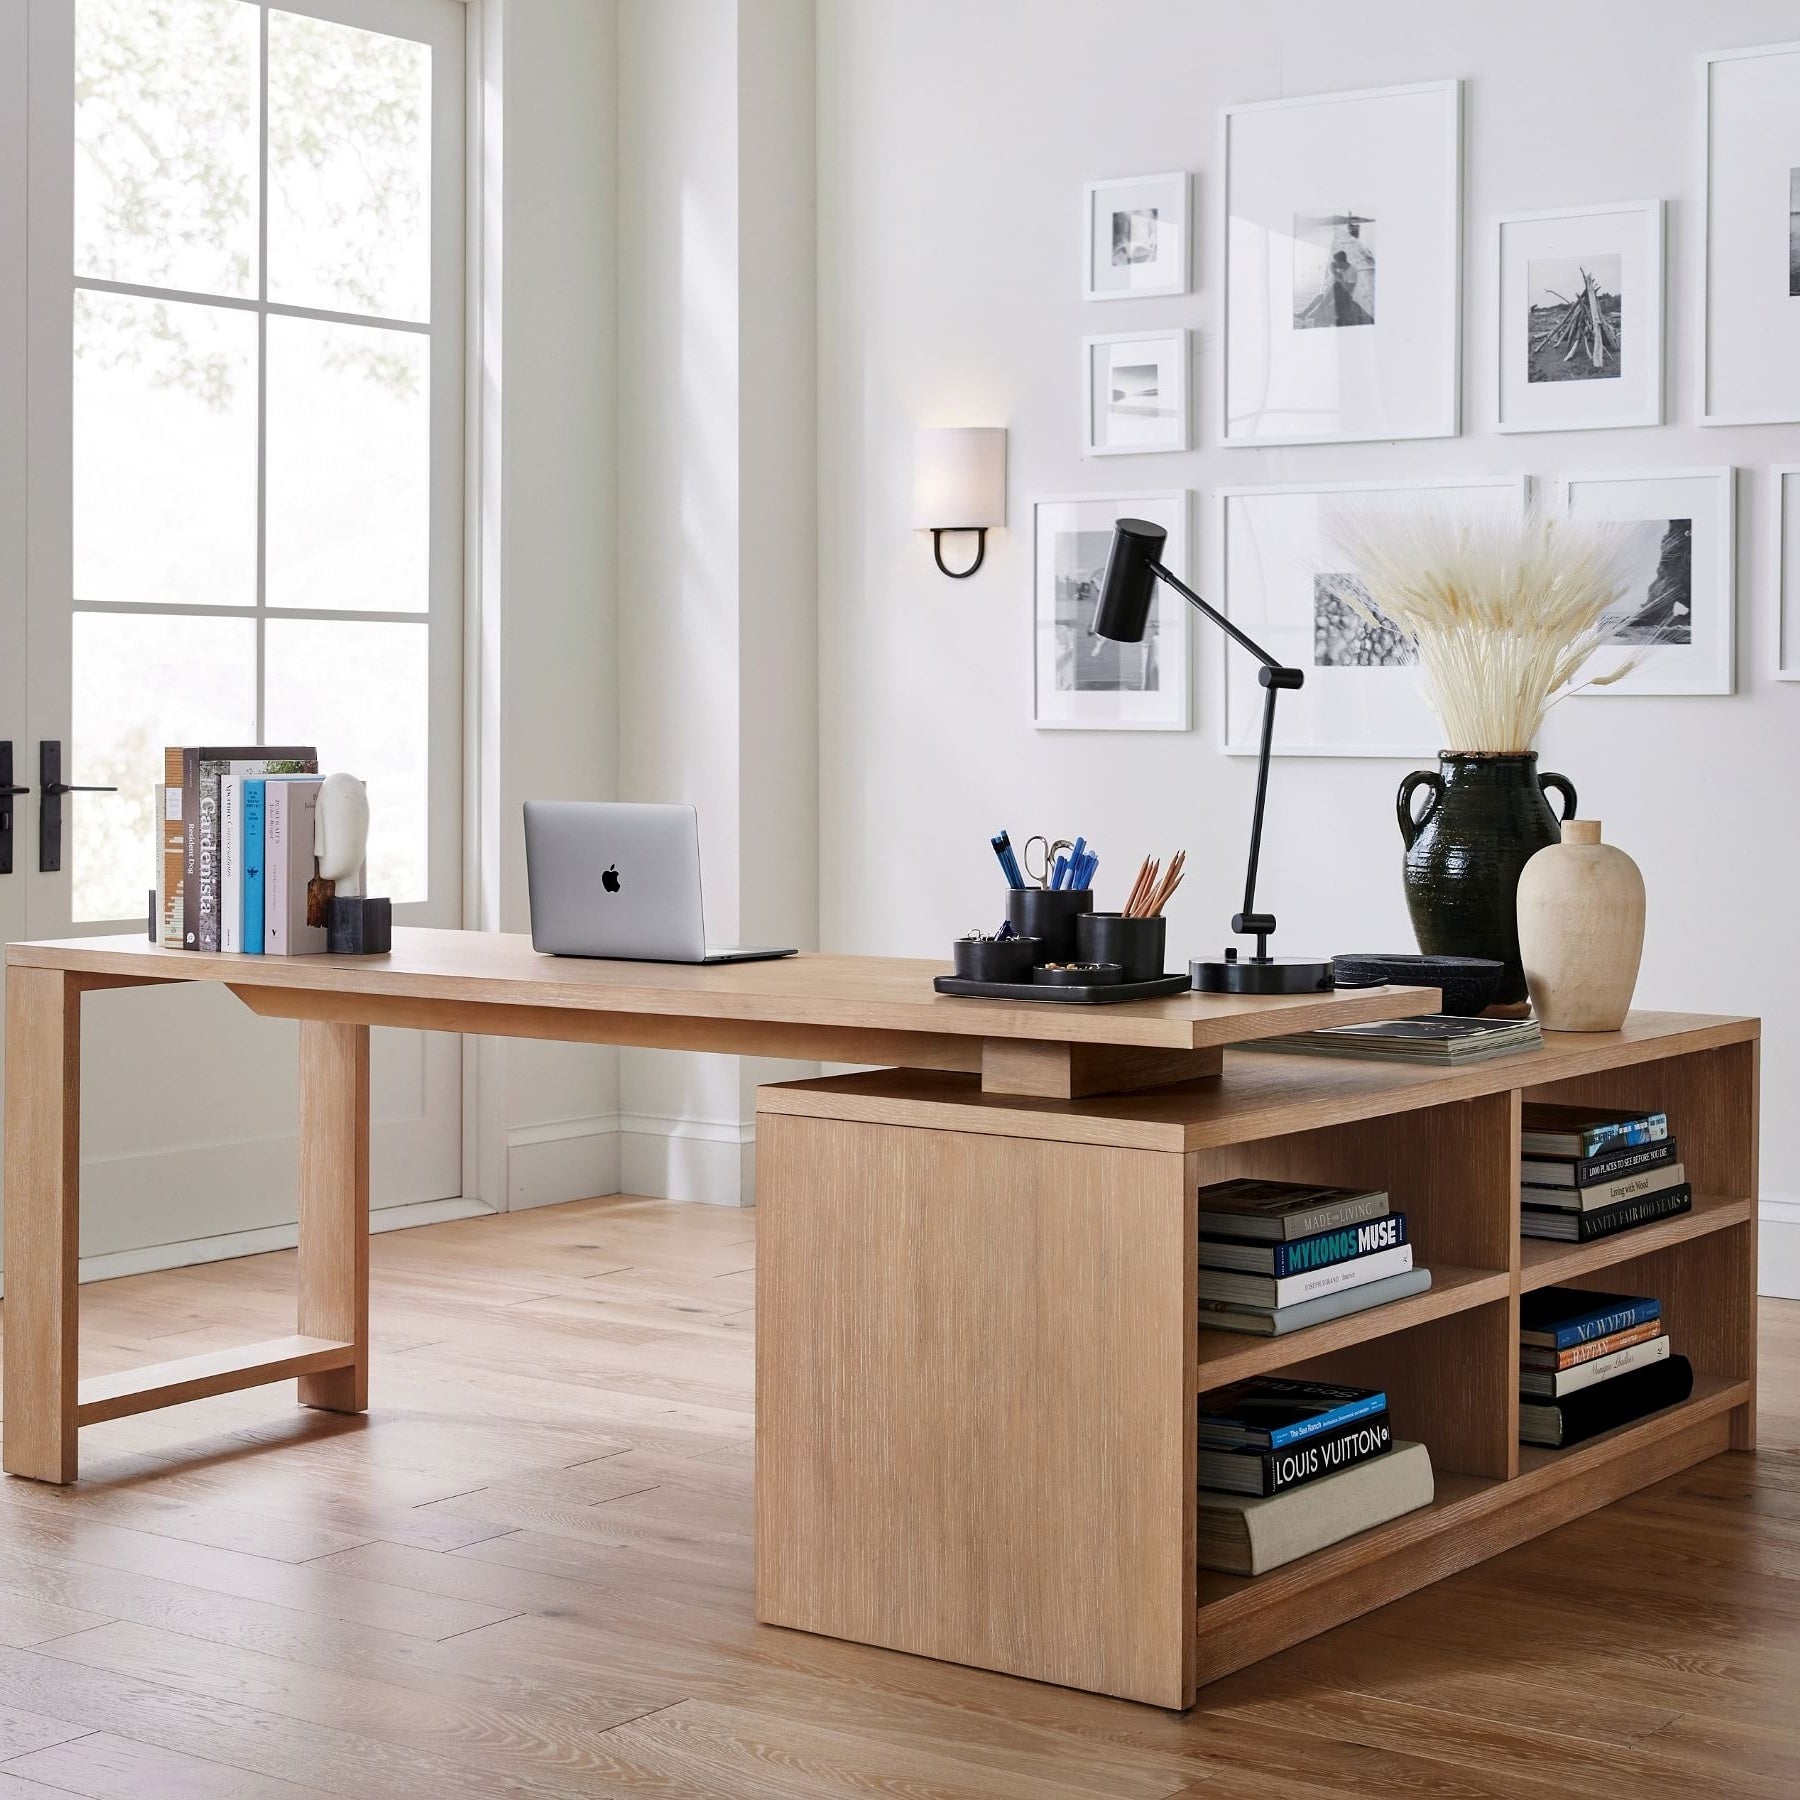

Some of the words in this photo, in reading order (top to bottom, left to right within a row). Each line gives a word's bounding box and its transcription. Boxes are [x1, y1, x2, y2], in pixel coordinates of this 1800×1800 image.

[187, 858, 195, 875] Dog
[200, 797, 217, 915] Gardenista
[1600, 1161, 1618, 1174] PLACES
[1617, 1160, 1623, 1169] TO
[1623, 1157, 1633, 1168] SEE
[1632, 1152, 1650, 1166] BEFORE
[1650, 1150, 1659, 1161] YOU
[1659, 1147, 1667, 1158] DIE
[1610, 1186, 1625, 1198] Living
[1624, 1182, 1636, 1193] with
[1635, 1178, 1649, 1191] Wood
[1304, 1213, 1332, 1232] MADE
[1339, 1202, 1373, 1223] LIVING
[1585, 1213, 1617, 1235] VANITY
[1618, 1206, 1638, 1226] FAIR
[1638, 1202, 1656, 1222] 100
[1655, 1195, 1681, 1214] YEARS
[1288, 1228, 1358, 1272] MYKONOS
[1357, 1219, 1397, 1253] MUSE
[1595, 1309, 1636, 1335] WYETH
[1572, 1340, 1609, 1364] RATTAN
[1289, 1429, 1299, 1438] The
[1298, 1426, 1308, 1436] Sea
[1307, 1421, 1322, 1432] Ranch
[1276, 1448, 1319, 1485] LOUIS
[1320, 1425, 1382, 1468] VUITTON
